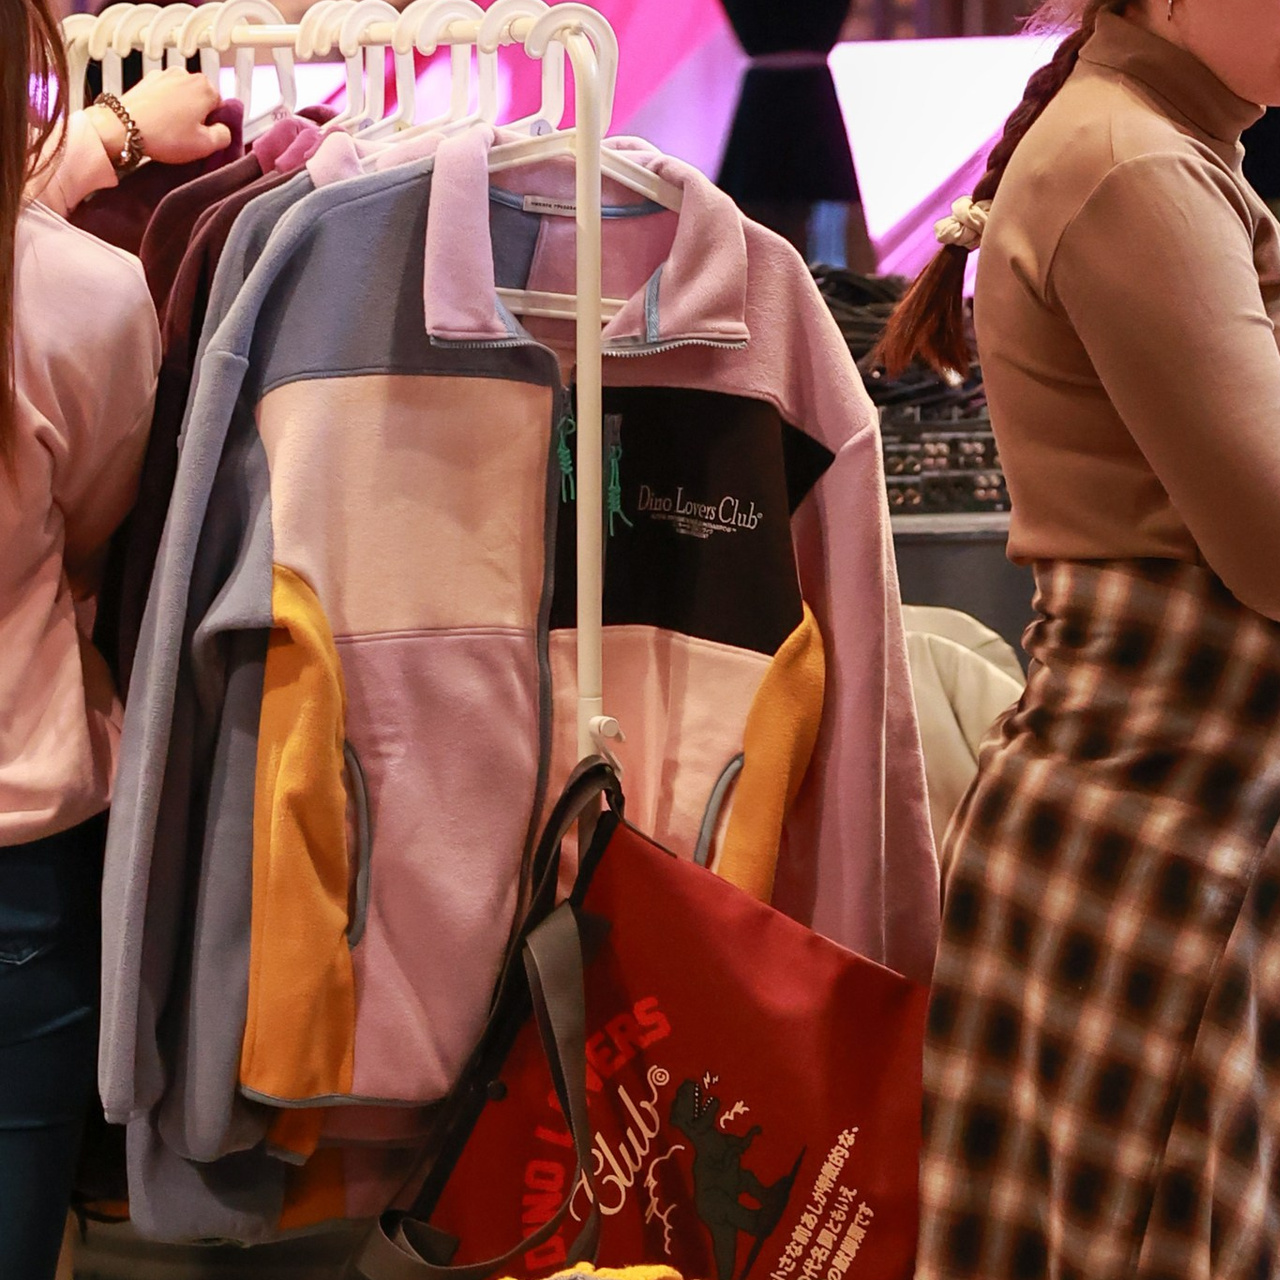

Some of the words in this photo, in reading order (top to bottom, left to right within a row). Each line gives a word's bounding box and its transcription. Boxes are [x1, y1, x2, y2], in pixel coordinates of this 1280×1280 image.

[638, 484, 673, 512] Dino
[675, 486, 717, 520] Lovers
[534, 996, 672, 1148] LERS
